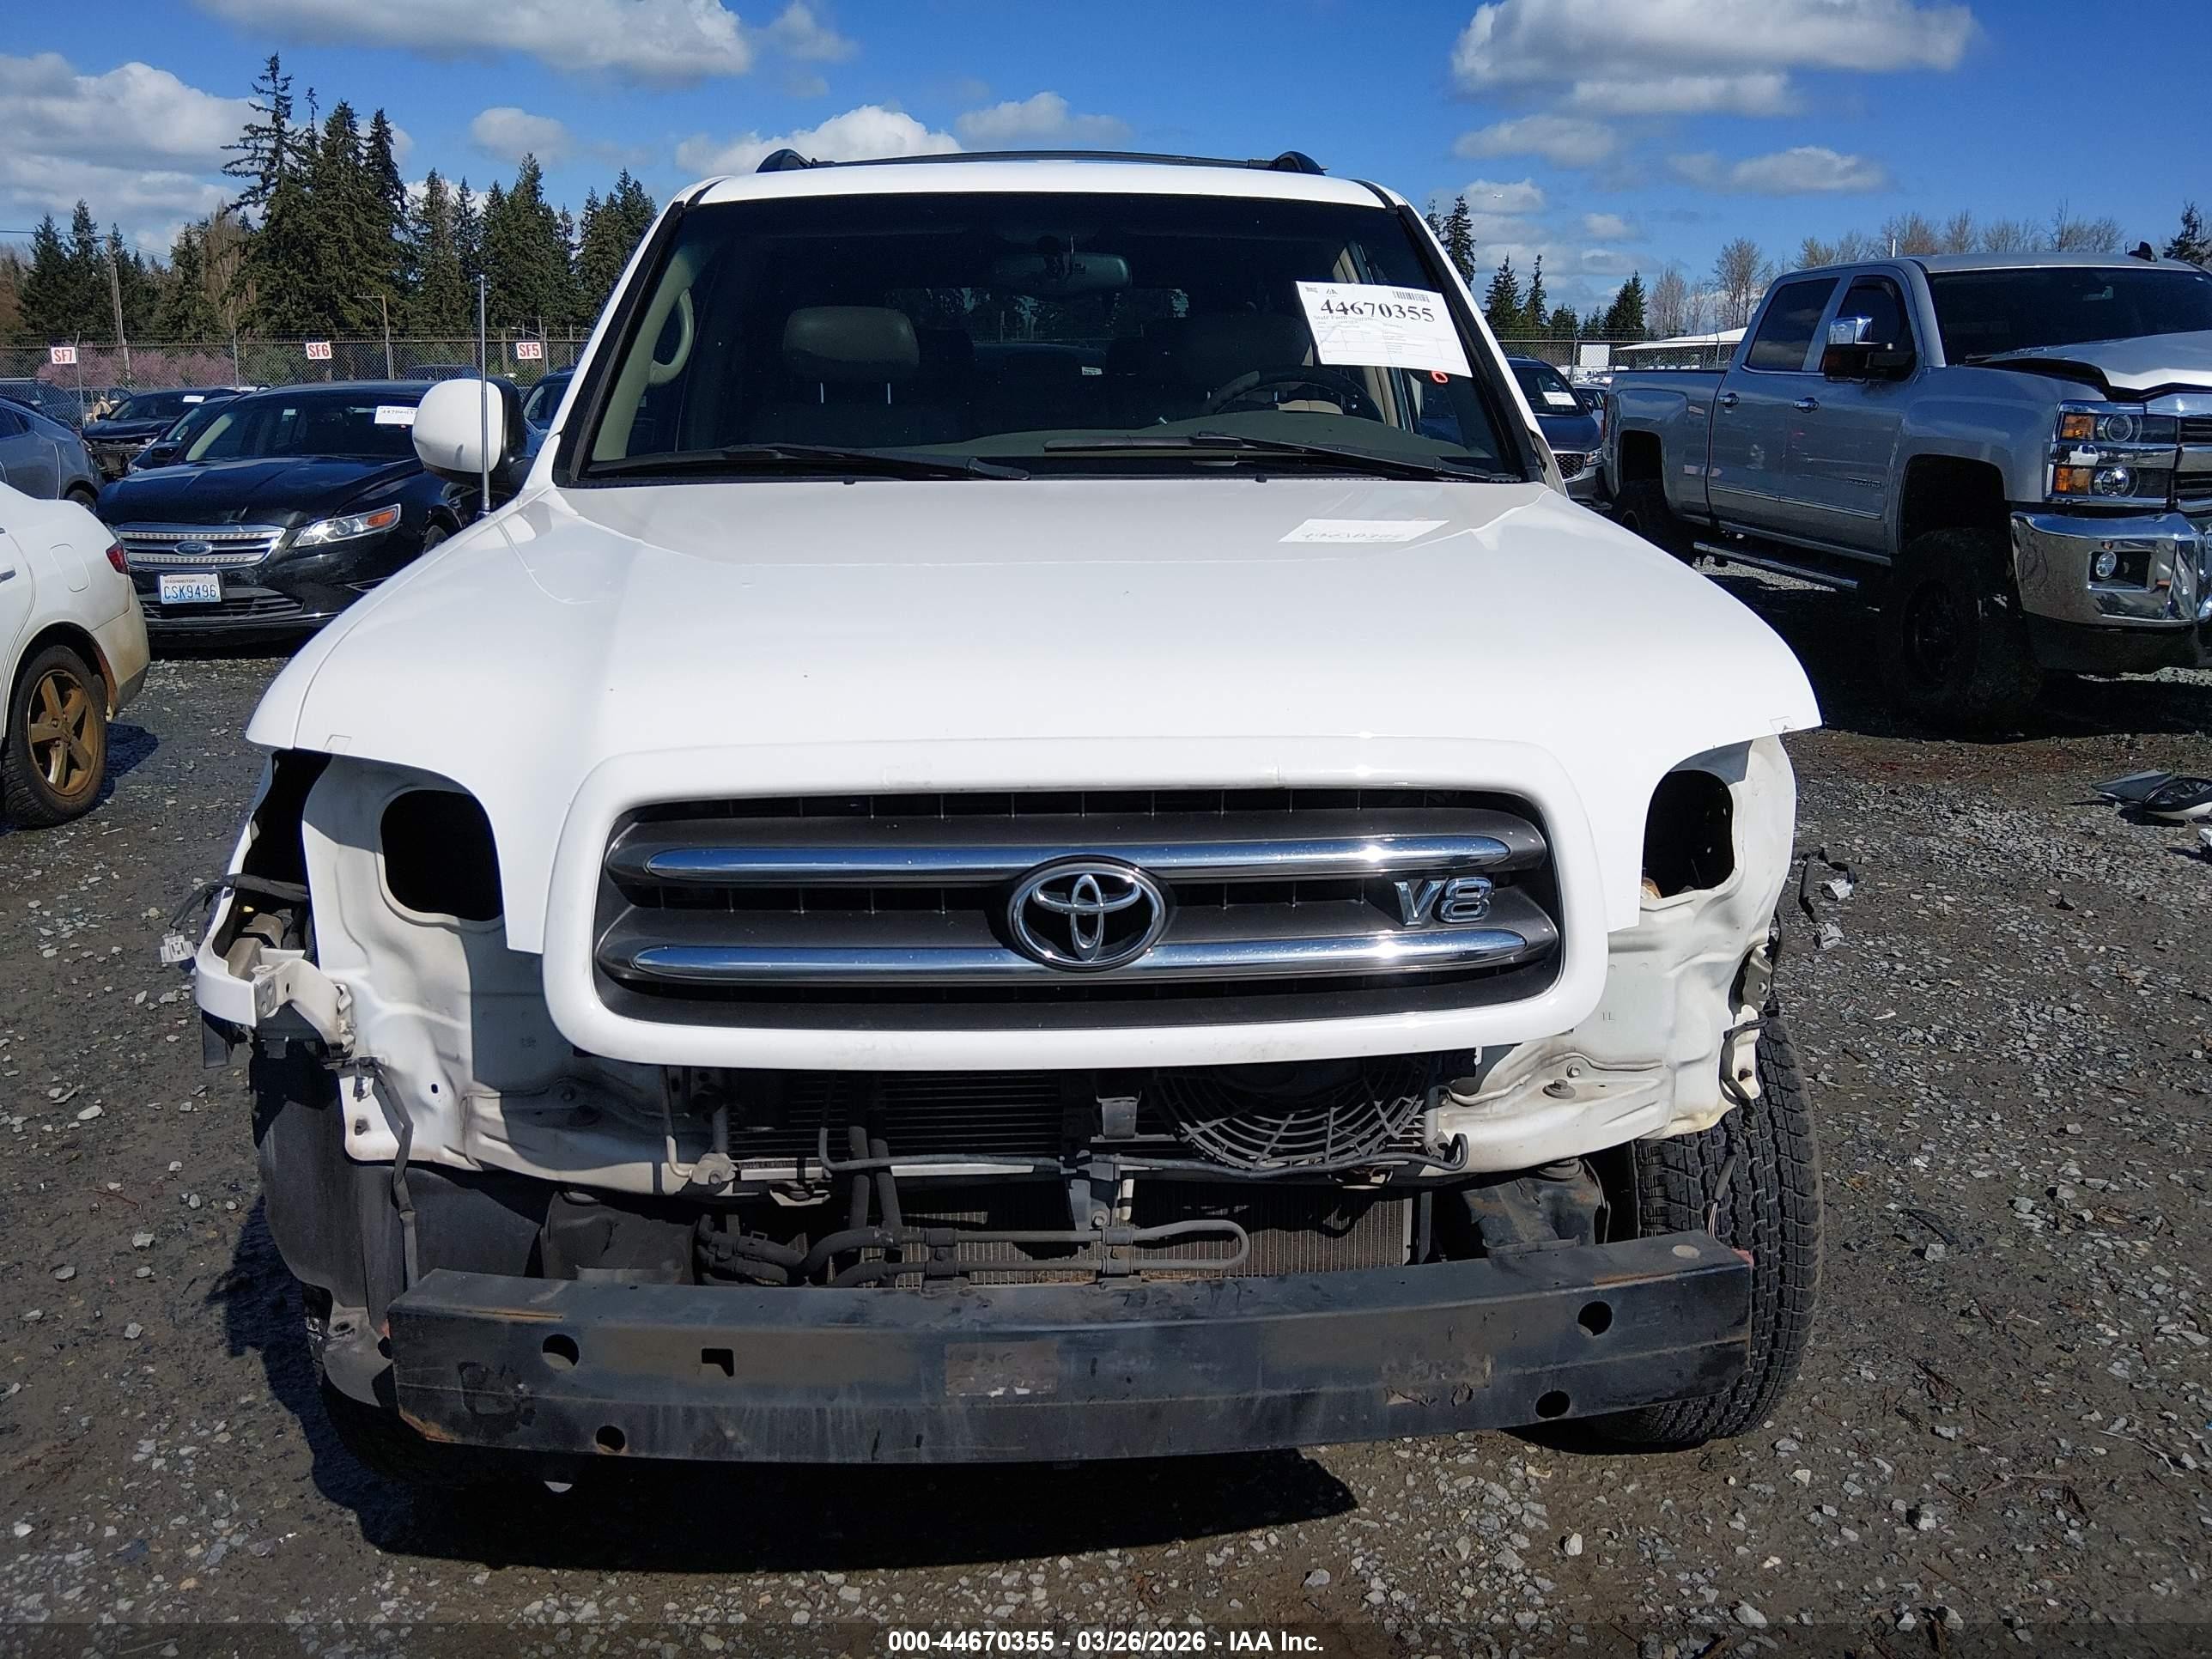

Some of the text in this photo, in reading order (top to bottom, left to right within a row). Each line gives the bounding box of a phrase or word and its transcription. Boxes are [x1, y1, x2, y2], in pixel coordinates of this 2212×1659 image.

[1321, 299, 1436, 323] 44670355
[54, 349, 72, 362] SF7
[308, 344, 329, 357] SF6
[519, 343, 539, 357] SF5
[163, 585, 216, 599] CSK9496
[1394, 877, 1492, 927] V8
